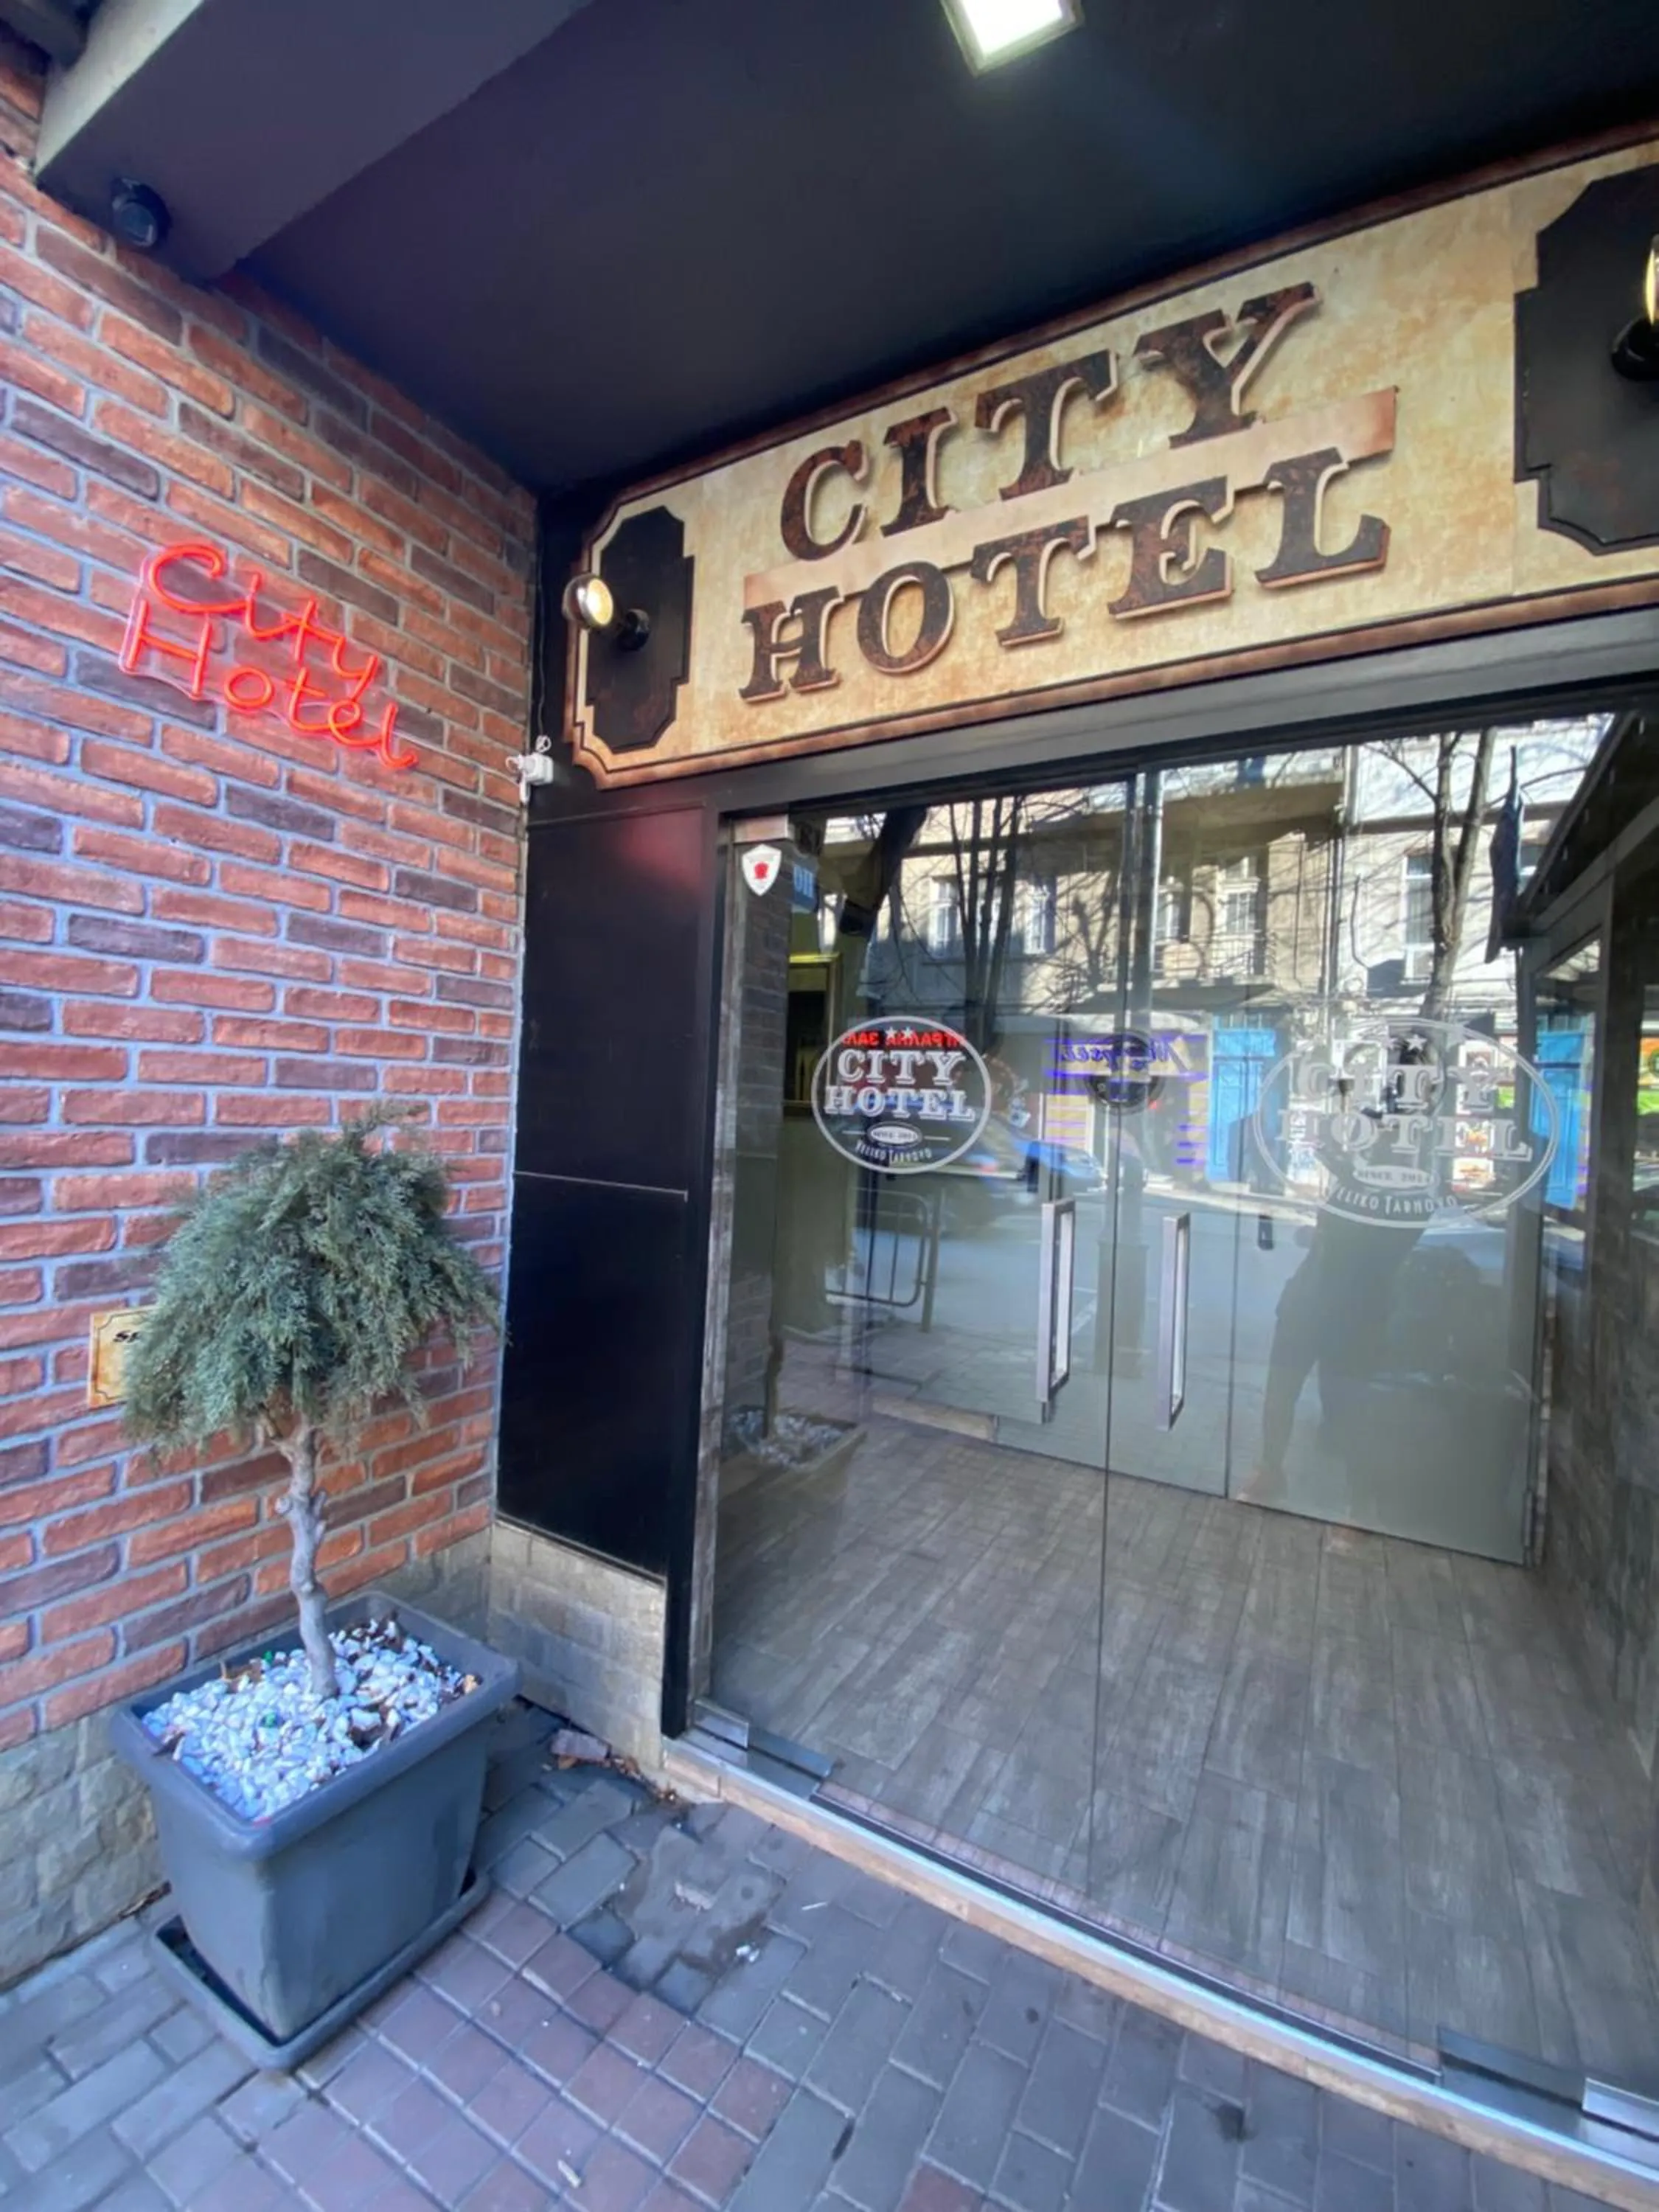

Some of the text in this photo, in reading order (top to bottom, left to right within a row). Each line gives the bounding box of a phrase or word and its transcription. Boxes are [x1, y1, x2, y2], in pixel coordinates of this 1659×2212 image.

[779, 280, 1322, 561] CITY
[148, 543, 379, 702] City
[738, 447, 1390, 703] HOTEL
[125, 599, 417, 768] Hotel
[824, 1085, 975, 1121] HOTEL
[838, 1048, 966, 1086] CITY
[1297, 1062, 1508, 1114] CITY
[1275, 1107, 1533, 1162] HOTEL
